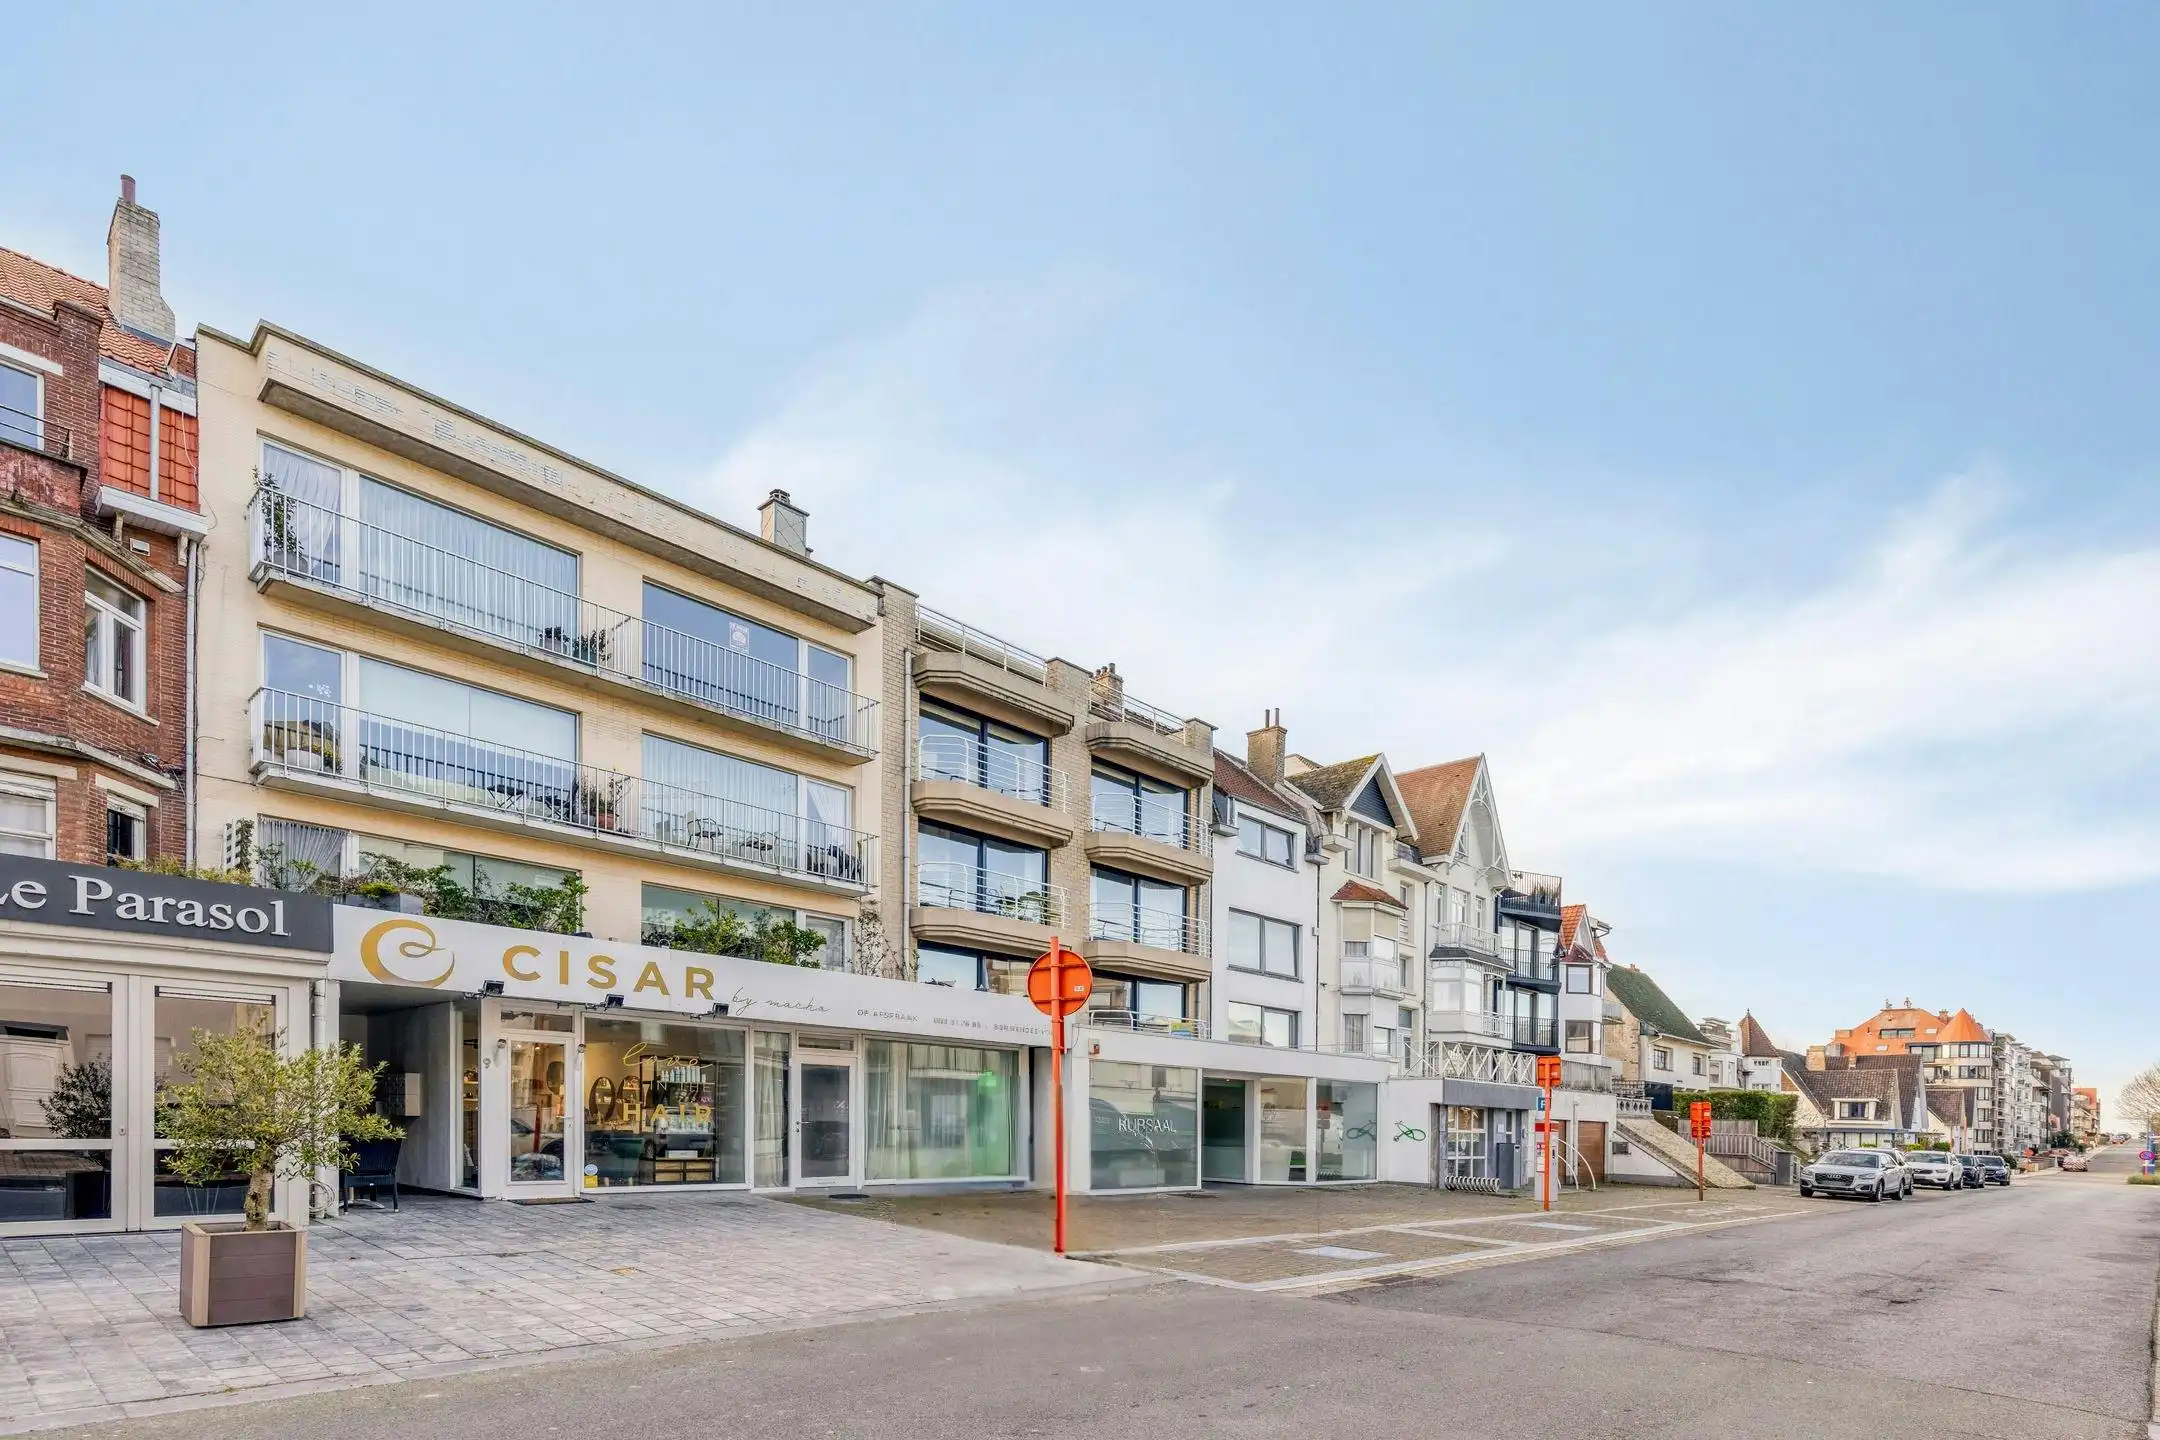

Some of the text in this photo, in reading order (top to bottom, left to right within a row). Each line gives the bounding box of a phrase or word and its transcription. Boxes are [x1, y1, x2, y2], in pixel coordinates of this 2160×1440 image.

[0, 875, 291, 937] e Parasol
[502, 945, 716, 1000] CISAR
[732, 987, 757, 1016] by
[622, 1042, 713, 1066] love
[650, 1081, 712, 1093] IN THE
[623, 1102, 713, 1123] HAIR
[1118, 1117, 1177, 1132] KURSAAL
